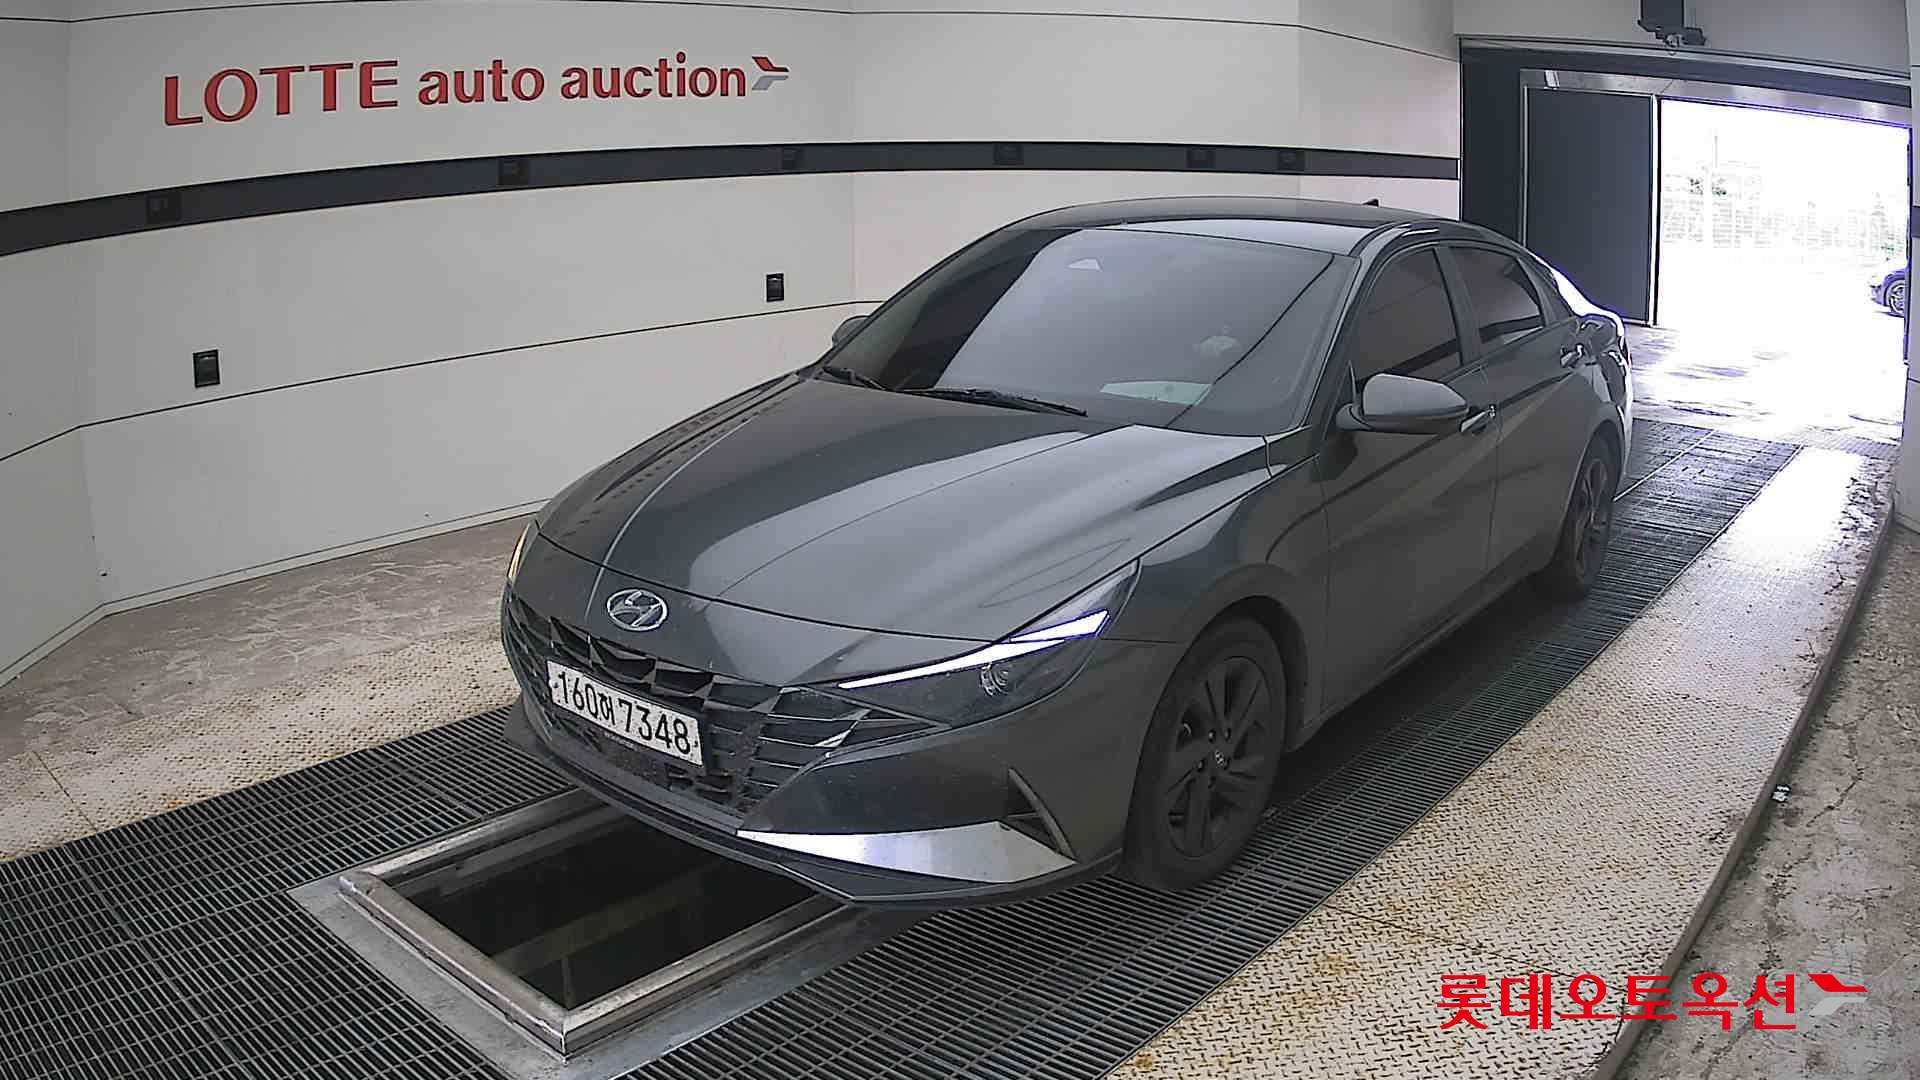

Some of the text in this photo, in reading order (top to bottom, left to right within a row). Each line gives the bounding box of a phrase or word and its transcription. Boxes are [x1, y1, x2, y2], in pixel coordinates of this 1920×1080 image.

[164, 51, 746, 126] LOTTE auto auction
